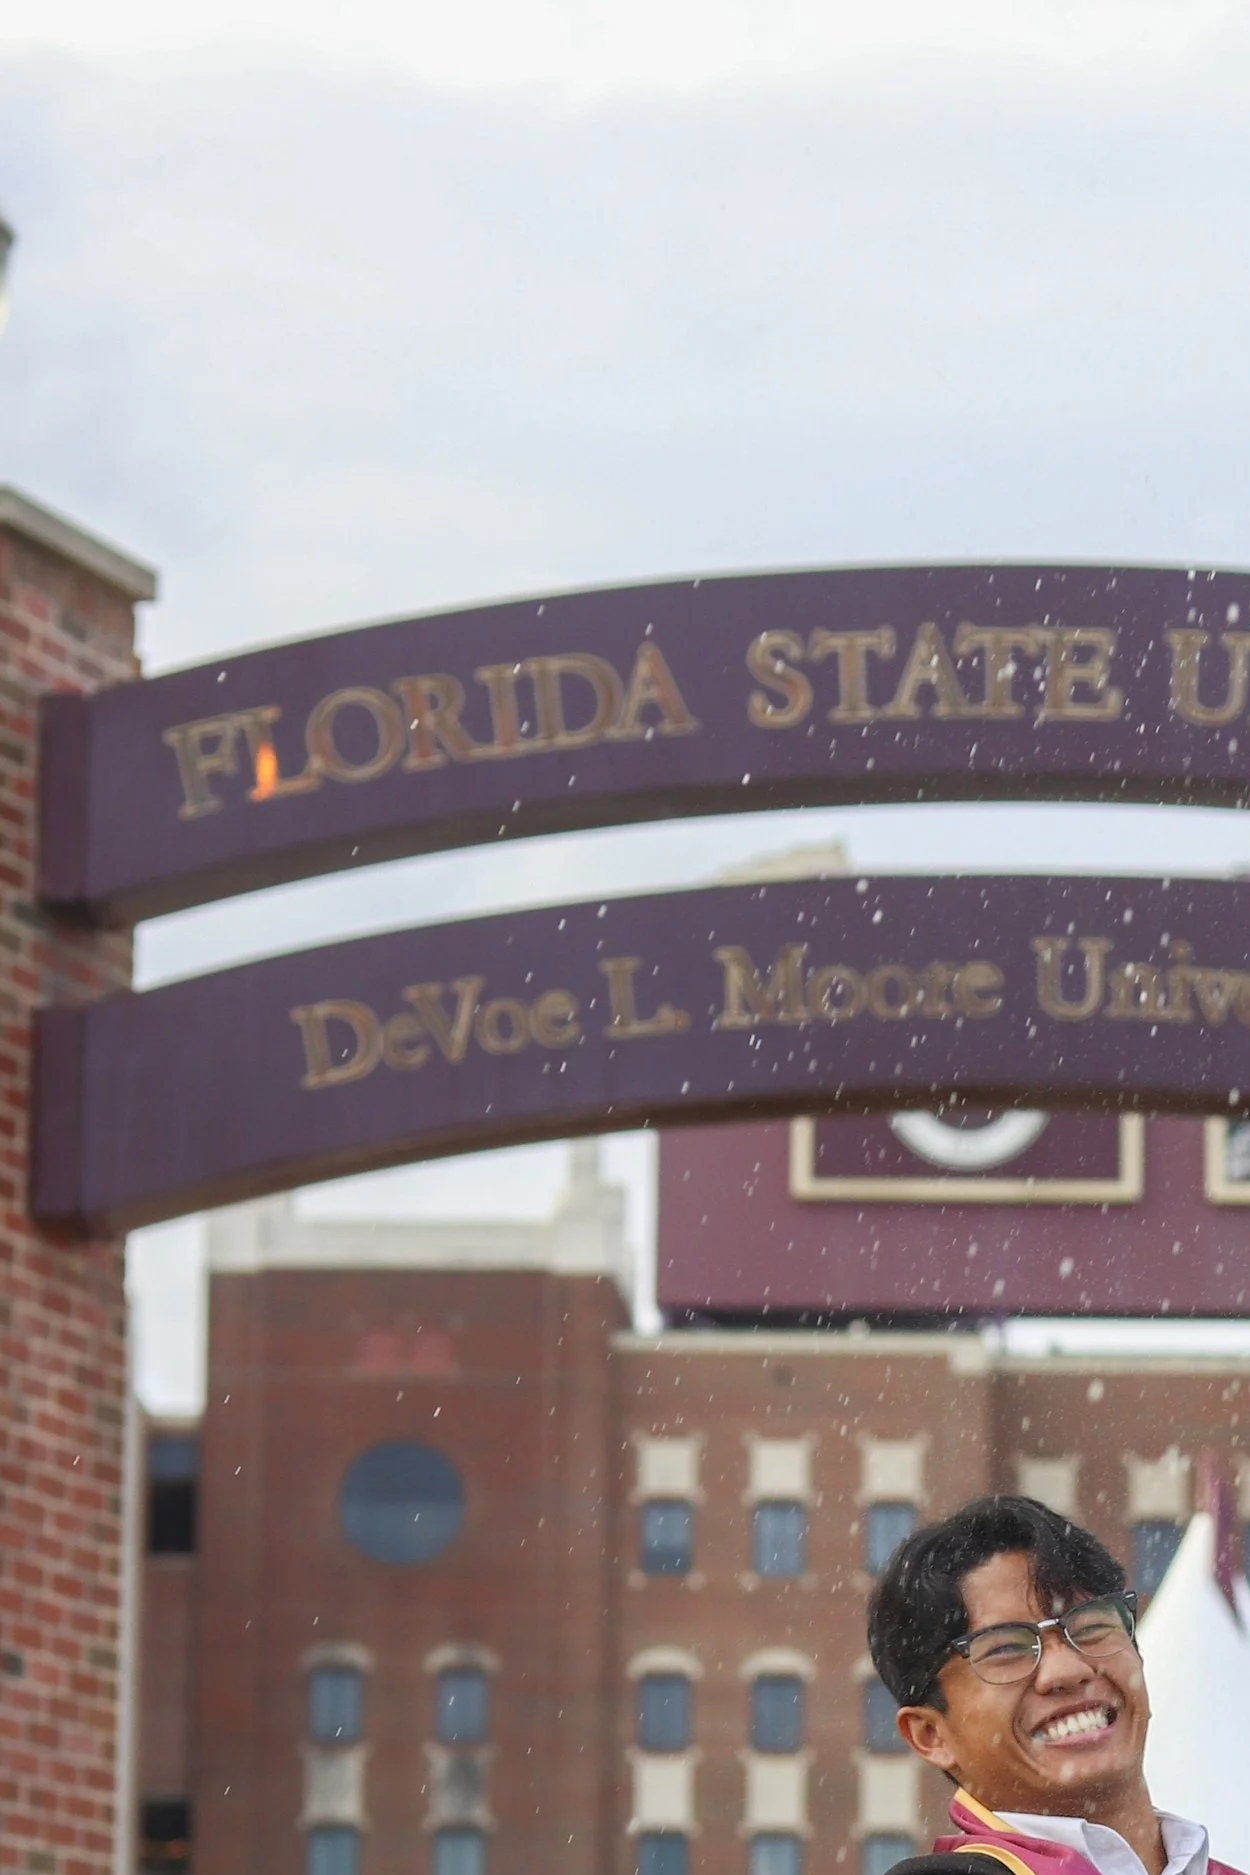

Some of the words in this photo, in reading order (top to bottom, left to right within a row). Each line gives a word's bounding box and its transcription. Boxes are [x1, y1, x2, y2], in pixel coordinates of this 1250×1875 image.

[163, 641, 698, 820] FLORIDA
[745, 622, 1123, 728] STATE
[290, 974, 581, 1092] DeVoe
[599, 956, 692, 1037] L.
[713, 942, 1004, 1031] Moore
